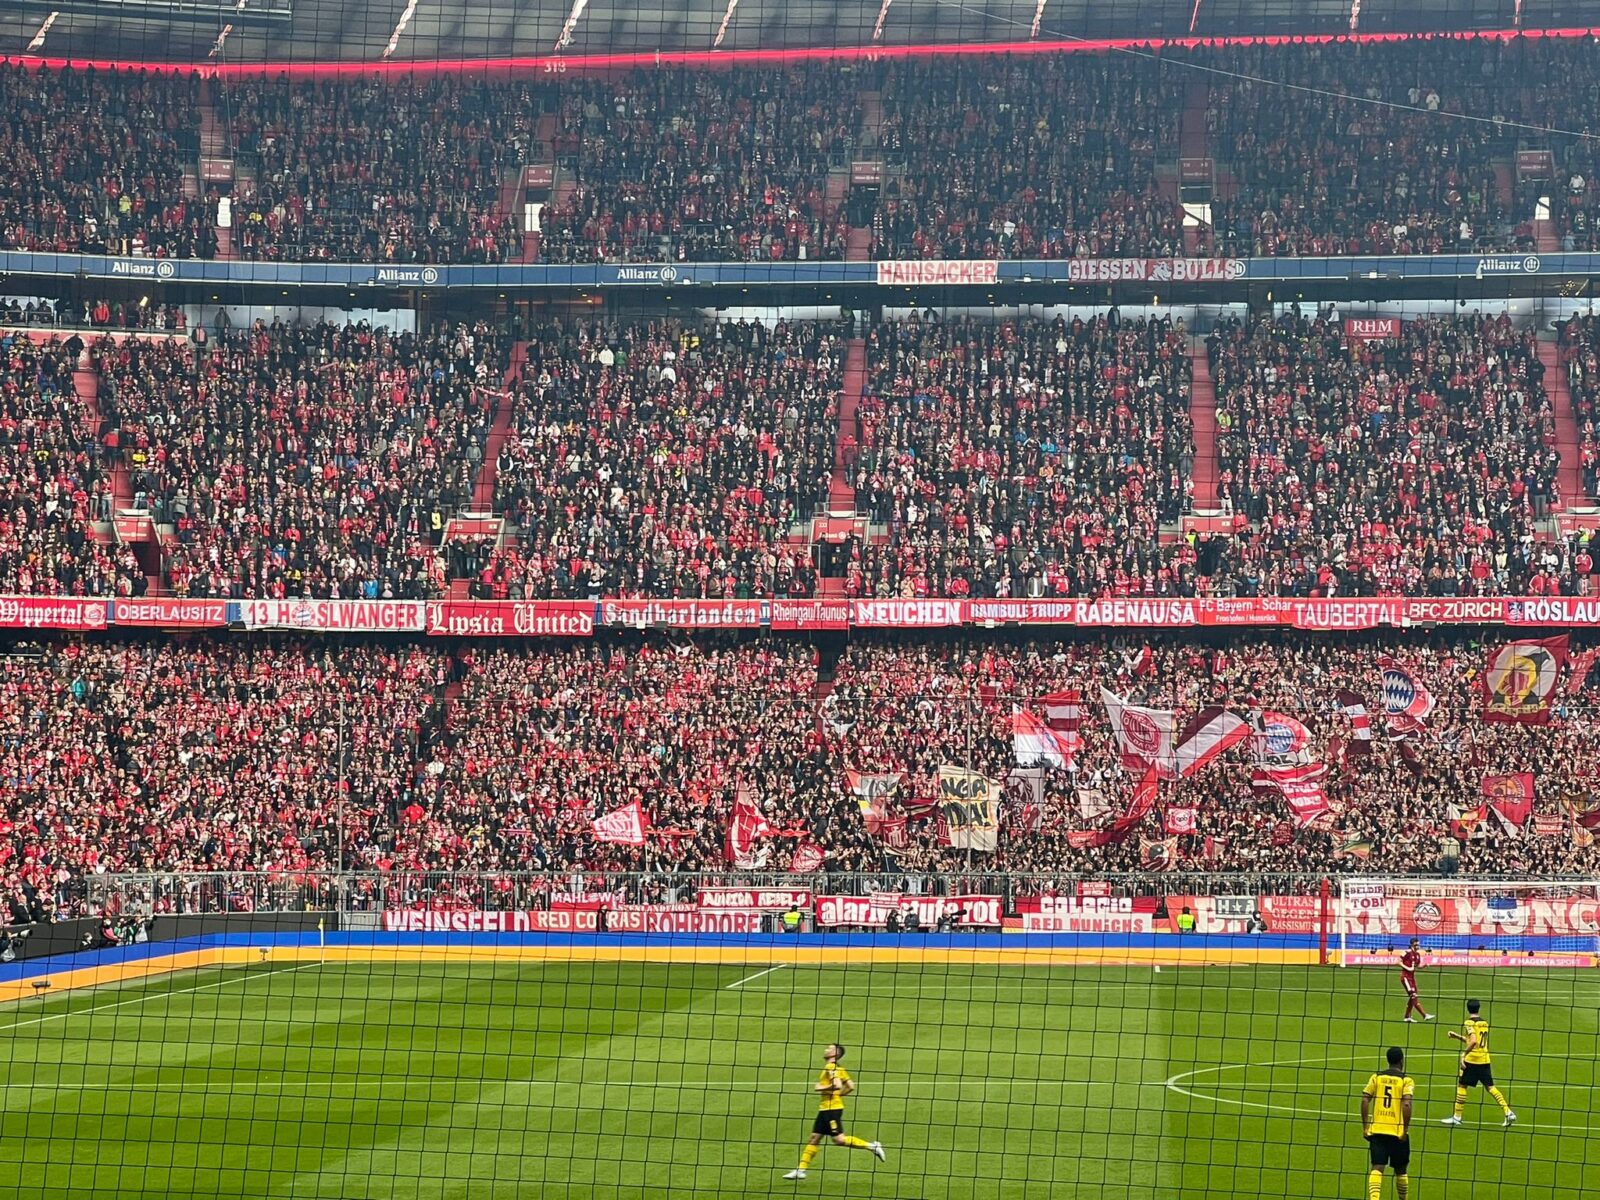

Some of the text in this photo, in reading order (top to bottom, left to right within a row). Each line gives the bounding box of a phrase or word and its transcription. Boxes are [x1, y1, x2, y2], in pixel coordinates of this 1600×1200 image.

[112, 262, 154, 274] Allianz
[1068, 259, 1236, 280] GIESSEN BULLS
[1477, 258, 1520, 270] Allianz
[377, 269, 419, 281] Allianz
[617, 268, 658, 279] Allianz
[879, 261, 997, 283] HAINSACKER
[1352, 320, 1393, 333] RHM
[0, 602, 82, 627] Wippertal
[117, 604, 223, 621] OBERLAUSITZ
[773, 602, 847, 625] Rheingau/Taunus
[1032, 603, 1071, 617] TRUPP
[1077, 601, 1196, 624] RABENAU/SA
[1200, 600, 1214, 611] FC
[1217, 600, 1253, 614] Bayern
[1263, 600, 1292, 610] Schar
[1409, 600, 1502, 618] BFC ZÜRICH
[427, 603, 592, 635] Lipsia United
[1294, 603, 1401, 627] TAUBERTAL
[1272, 897, 1314, 907] ULTRAS
[1351, 897, 1384, 908] TOBI
[962, 898, 1000, 923] rot
[1272, 908, 1315, 919] GEGEN
[537, 912, 640, 929] RED CORAS
[1031, 918, 1062, 932] RED
[1272, 920, 1315, 931] RASSISMUS
[1383, 1085, 1393, 1109] 5
